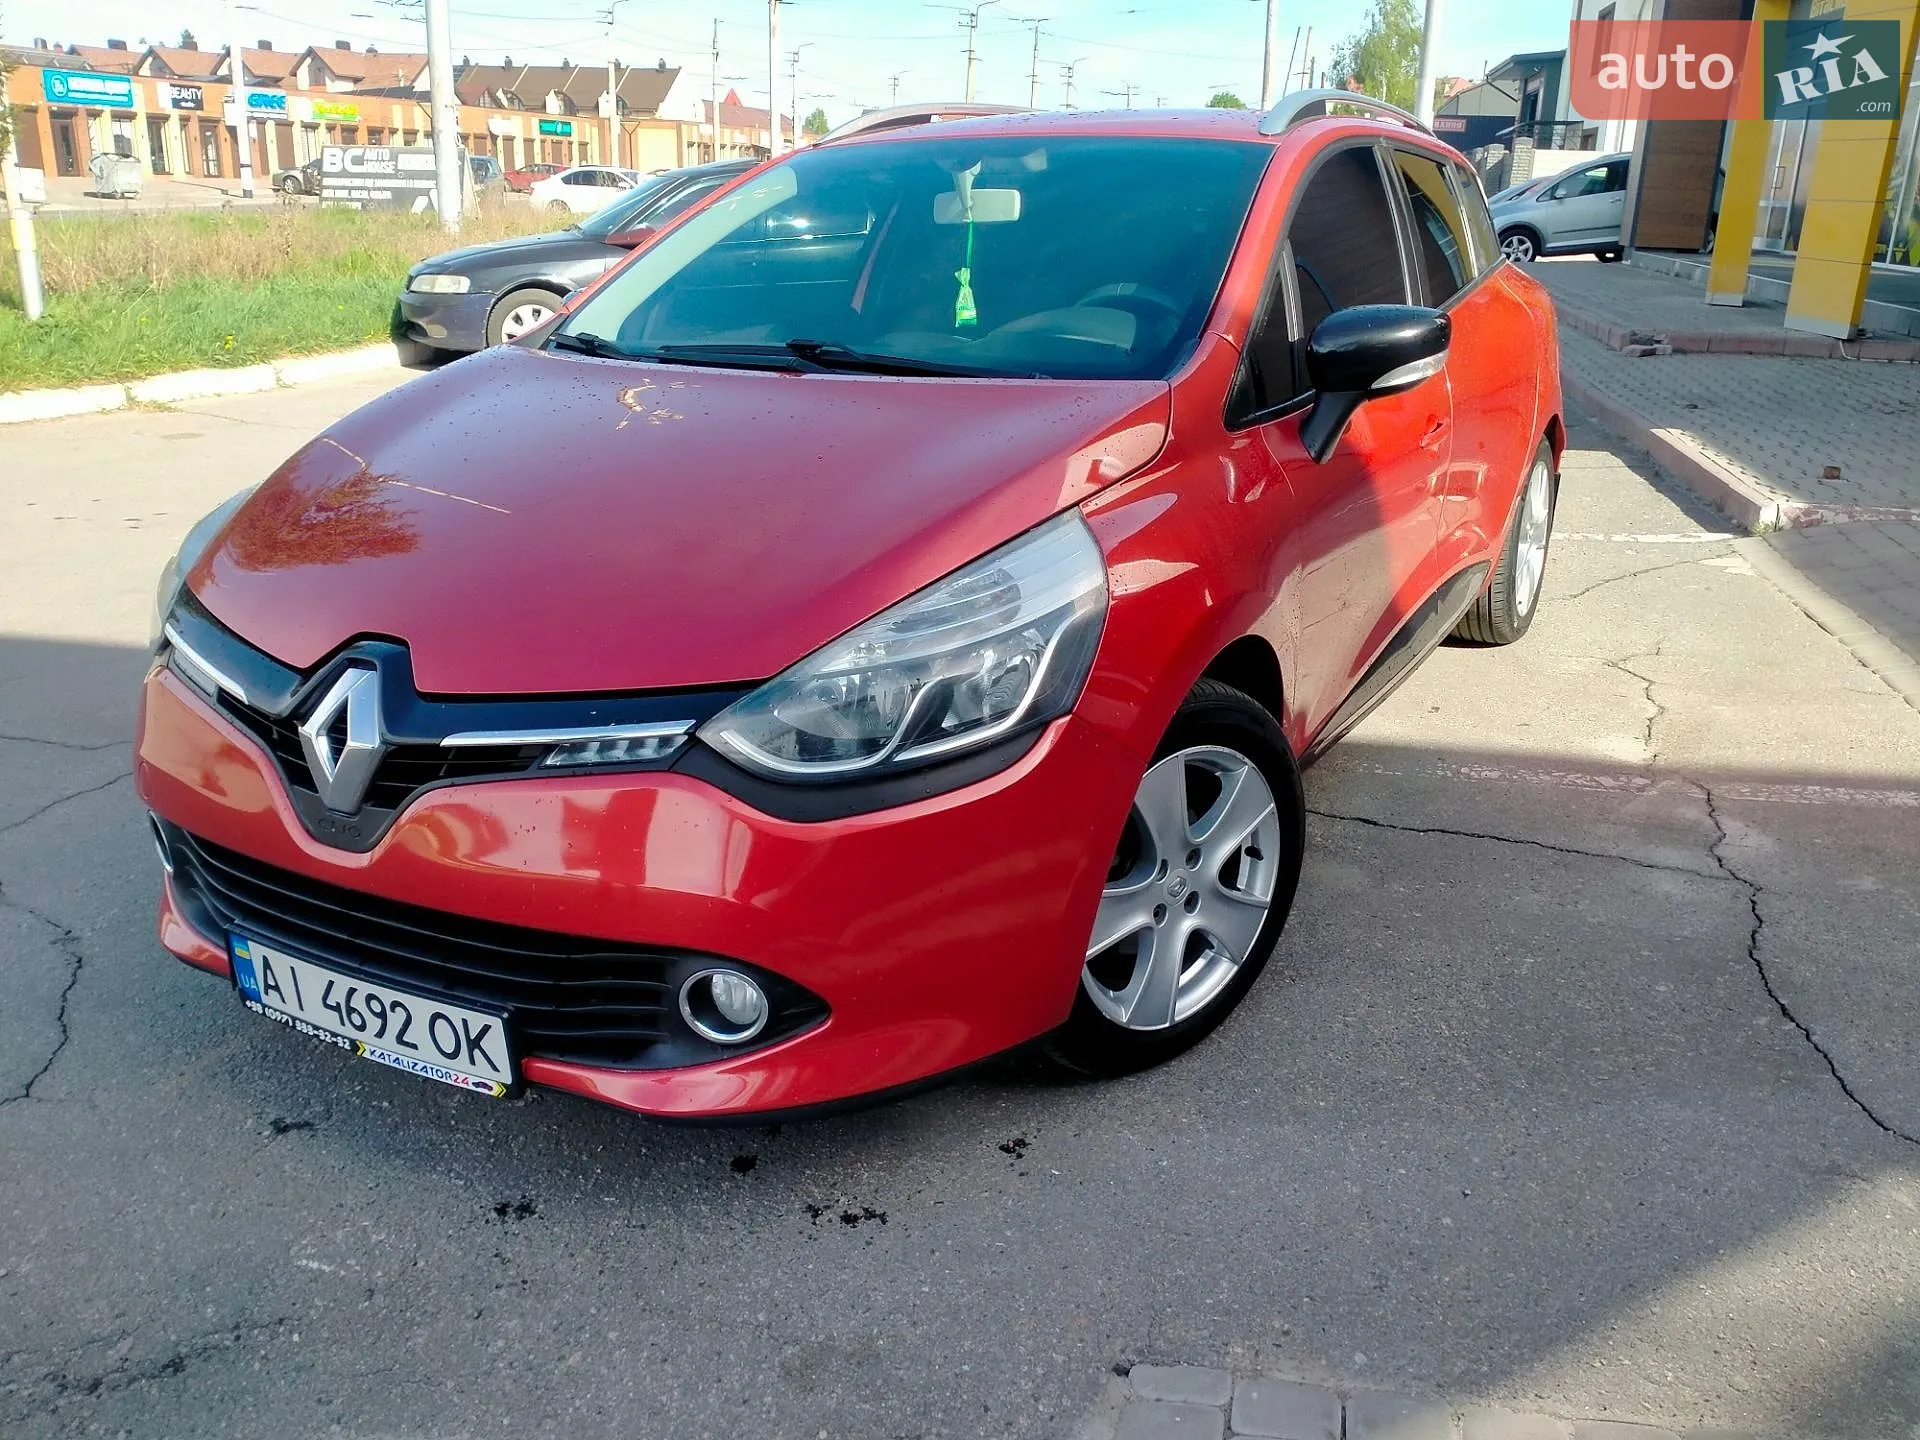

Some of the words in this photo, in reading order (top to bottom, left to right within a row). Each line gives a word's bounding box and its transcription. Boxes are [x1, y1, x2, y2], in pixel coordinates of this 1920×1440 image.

[168, 86, 203, 100] BEAUTY
[322, 147, 365, 173] BC
[364, 148, 390, 161] AUTO
[363, 160, 396, 174] HOUSE
[241, 973, 259, 992] UA
[262, 954, 304, 1012] AI
[321, 979, 418, 1051] 4692
[428, 1011, 500, 1073] OK
